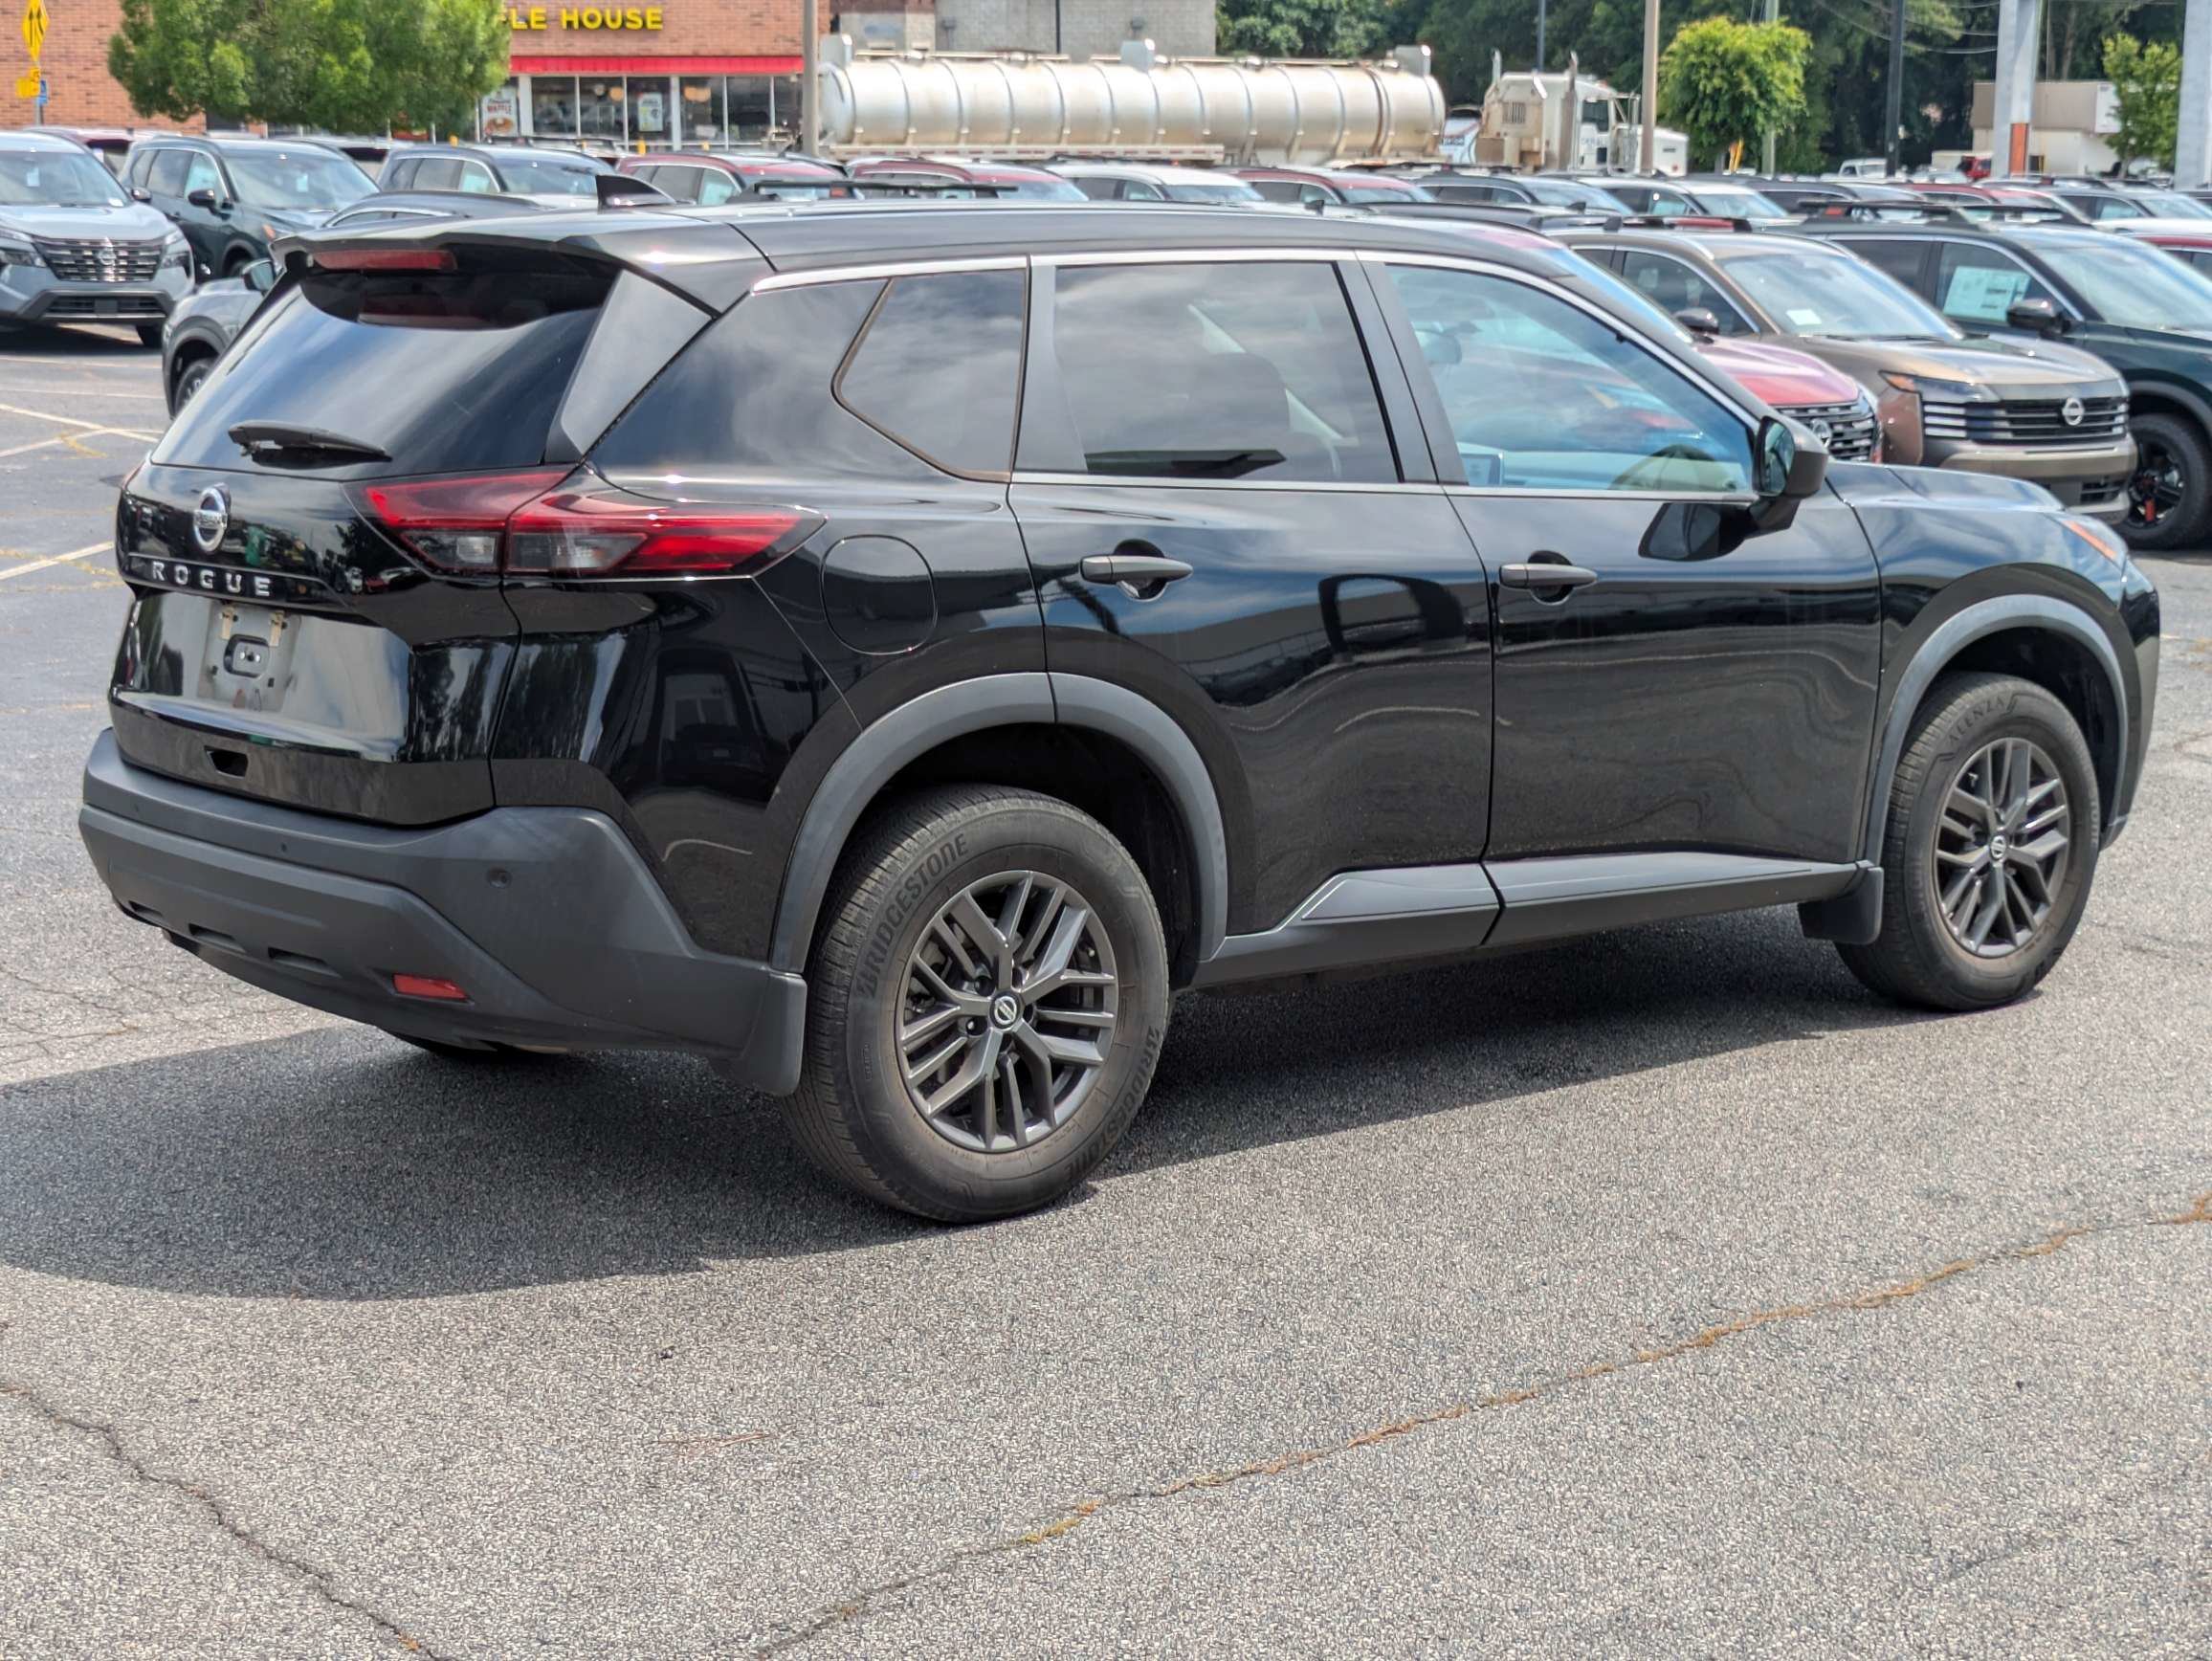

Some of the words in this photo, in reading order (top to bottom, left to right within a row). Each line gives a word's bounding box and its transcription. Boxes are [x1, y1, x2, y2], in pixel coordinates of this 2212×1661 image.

[501, 7, 548, 31] LE
[560, 7, 663, 31] HOUSE
[150, 560, 272, 598] ROGUE
[1948, 696, 2005, 743] ALENZA
[856, 832, 969, 998] BRIDGESTONE
